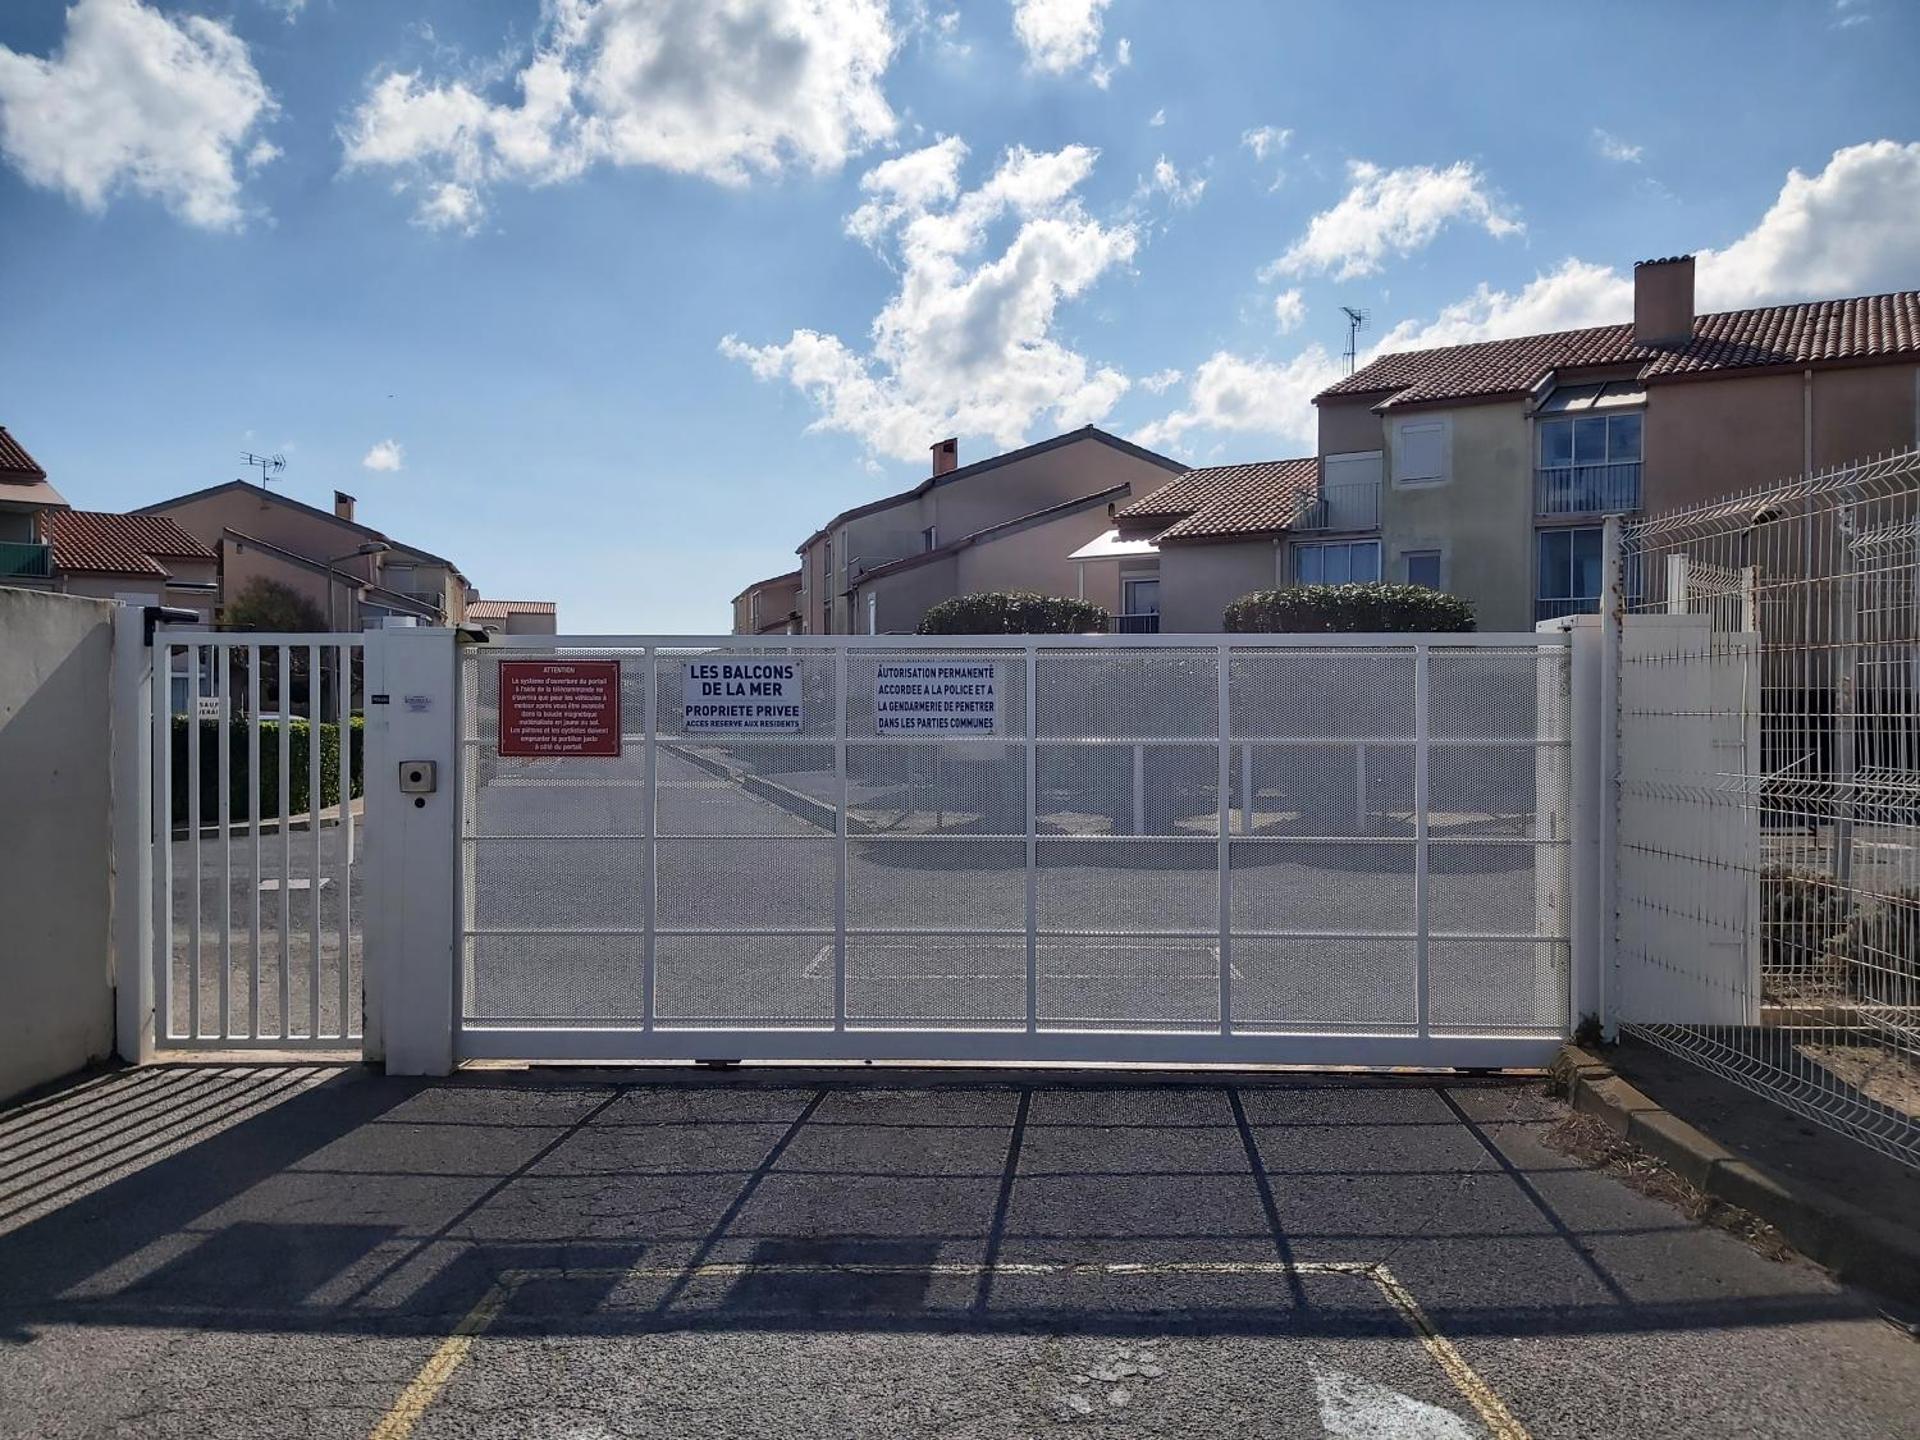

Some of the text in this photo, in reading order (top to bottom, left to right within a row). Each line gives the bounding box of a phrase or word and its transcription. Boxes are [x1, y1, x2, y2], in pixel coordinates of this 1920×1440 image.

[691, 665, 793, 679] LES BALCONS
[877, 667, 936, 678] AUTORISATION
[702, 682, 783, 696] DE LA MER
[878, 685, 994, 695] ACCORDEE A LA POLICE ET A
[685, 705, 800, 717] PROPRIETE PRIVEE
[877, 701, 994, 712] LA GENDARMERIE DE PENETRER
[686, 720, 800, 728] ACCES RESERVE AUX RESIDENTS
[878, 718, 994, 728] DANS LES PARTIES COMMUNES
